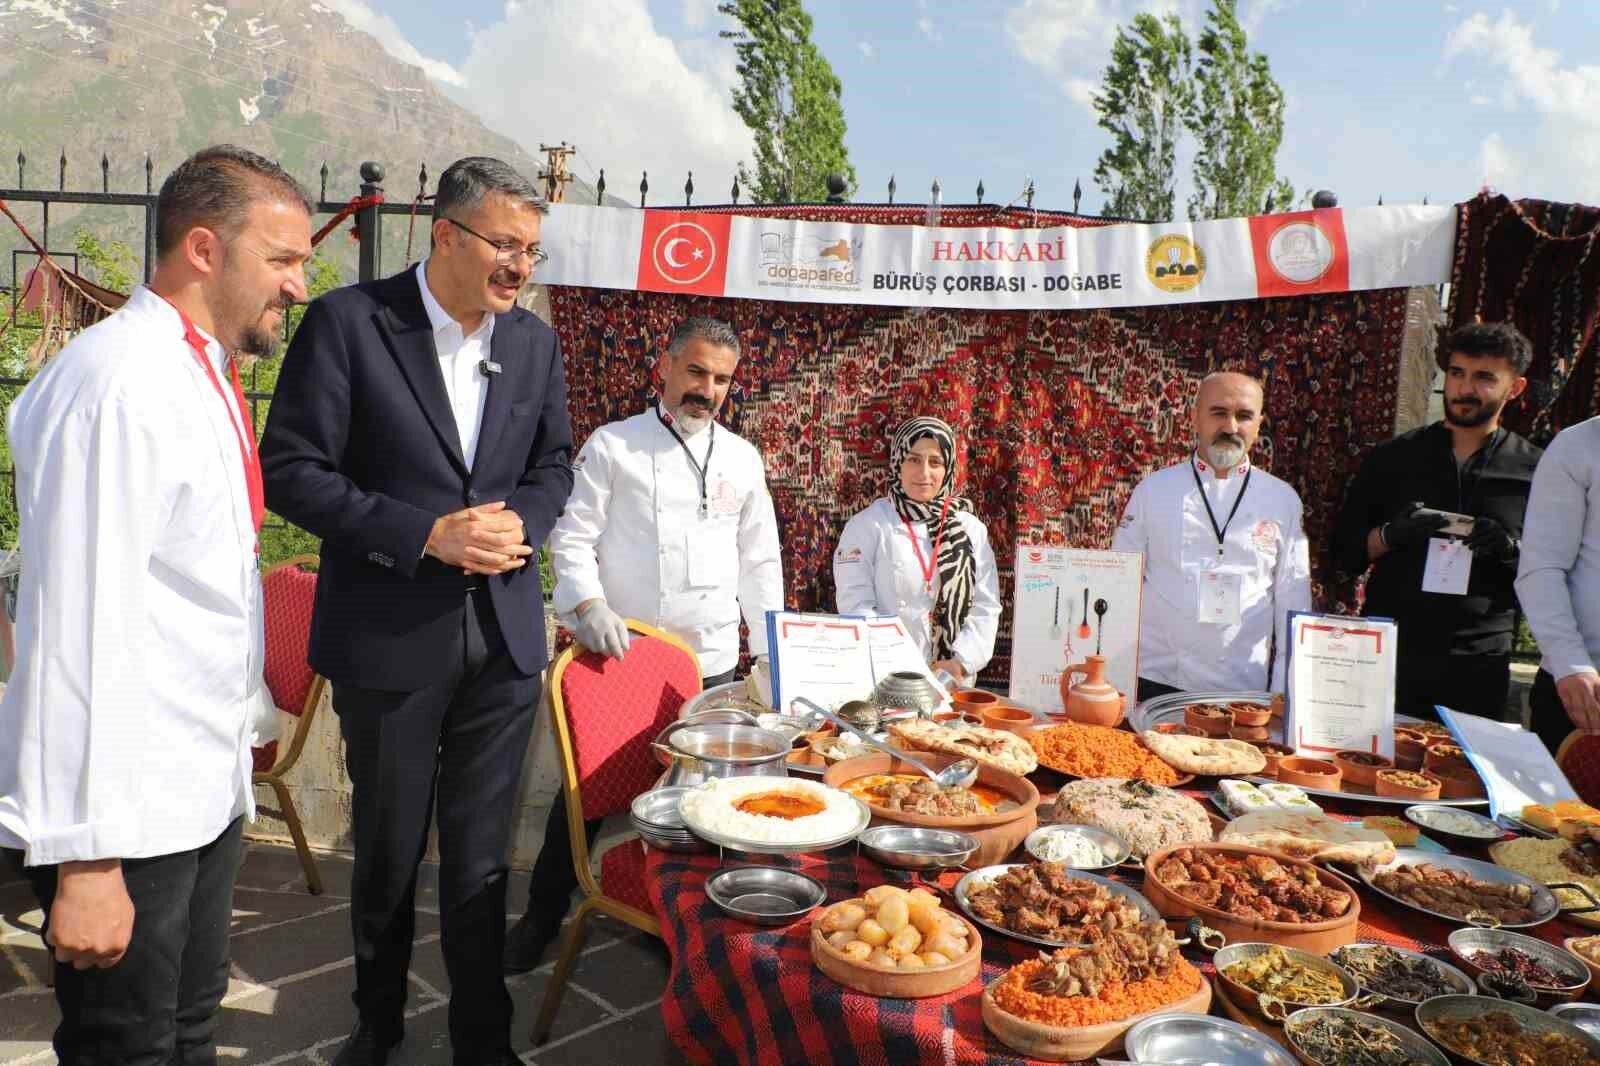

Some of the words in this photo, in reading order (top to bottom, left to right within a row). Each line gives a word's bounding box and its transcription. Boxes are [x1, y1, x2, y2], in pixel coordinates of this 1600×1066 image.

[932, 237, 1066, 262] HAKKARİ
[873, 272, 937, 295] BÜRÜŞ
[943, 274, 1026, 295] ÇORBASI
